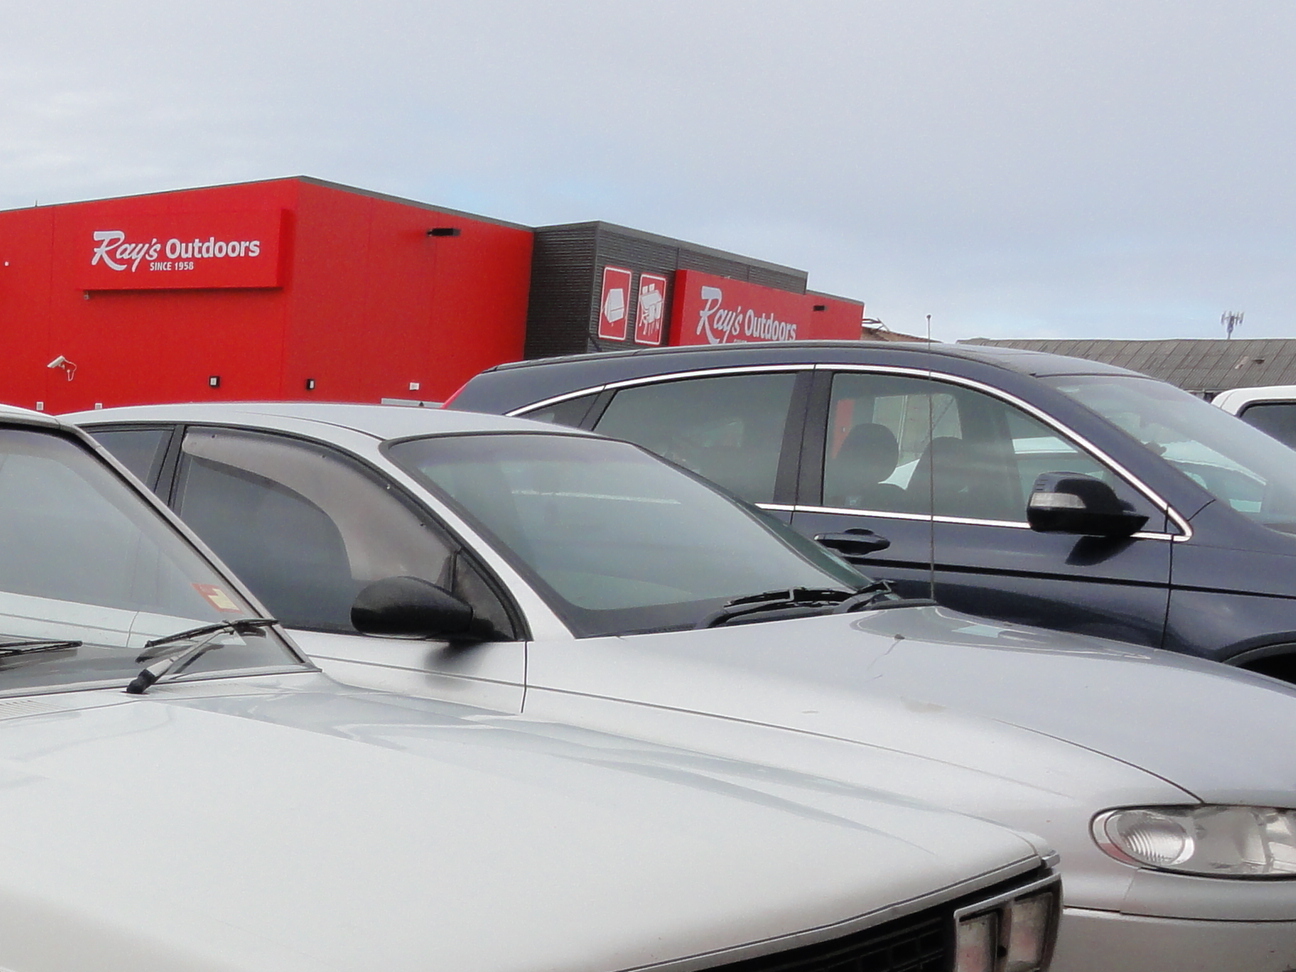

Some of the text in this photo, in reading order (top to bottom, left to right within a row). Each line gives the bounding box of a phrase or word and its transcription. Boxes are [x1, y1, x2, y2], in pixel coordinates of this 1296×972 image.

[91, 230, 261, 272] Ray's Outdoors
[149, 261, 194, 271] SINCE 1958
[696, 285, 797, 344] Ray's Outdoors
